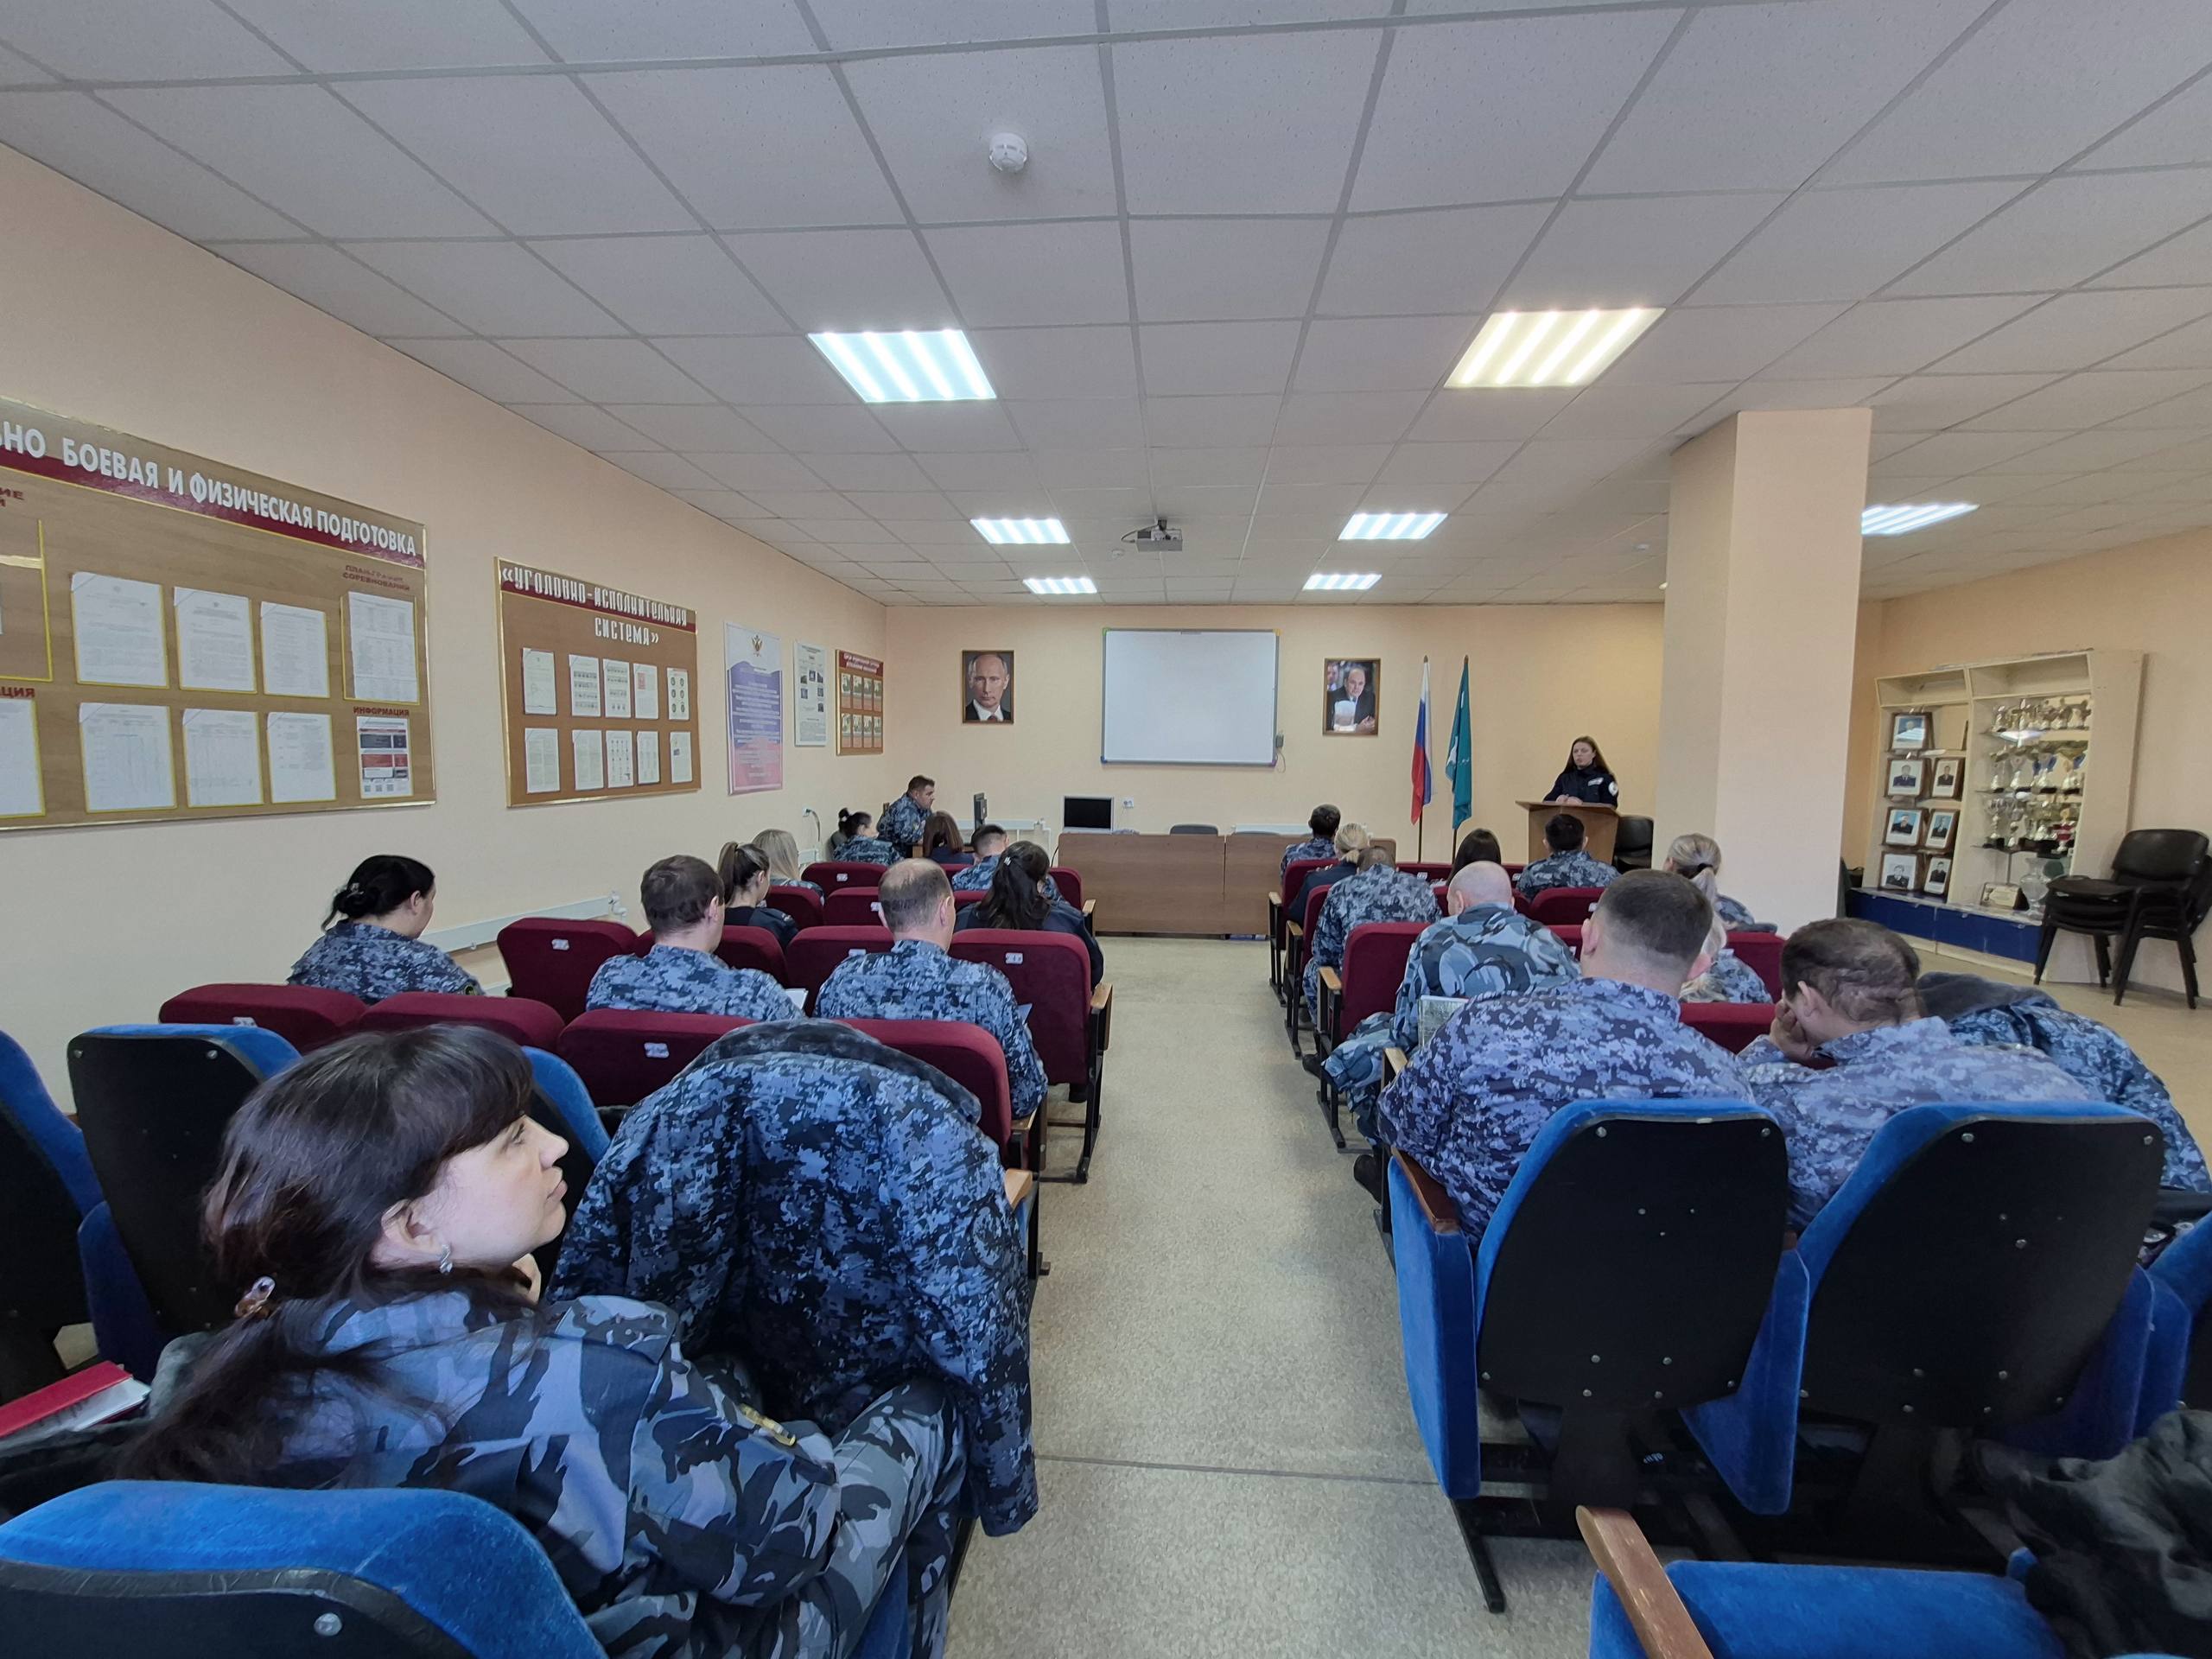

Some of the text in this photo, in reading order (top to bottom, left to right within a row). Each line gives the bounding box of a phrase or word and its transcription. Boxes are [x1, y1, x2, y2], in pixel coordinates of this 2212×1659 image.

[0, 421, 416, 556] НО БОЕВАЯ И ФИЗИЧЕСКАЯ ПОДГОТОВКА
[353, 706, 410, 717] ИНФОРМАЦИЯ
